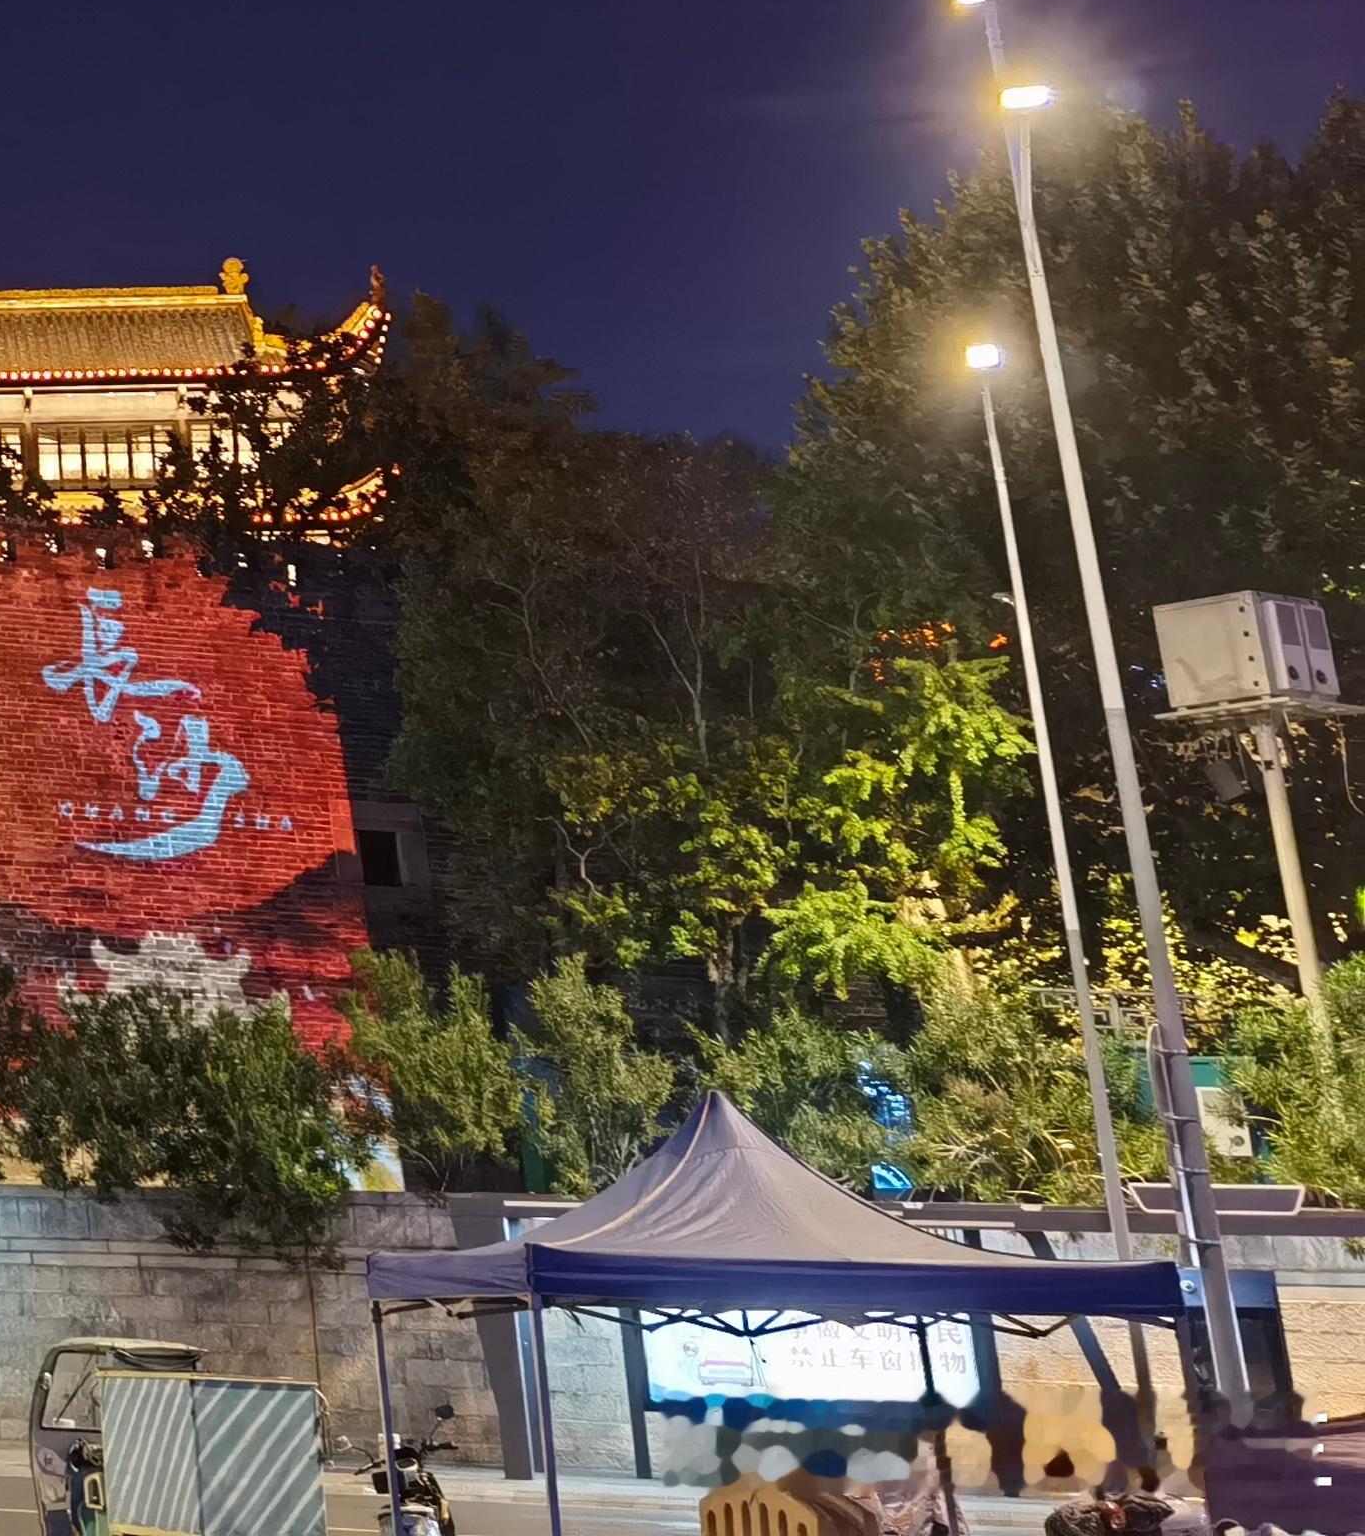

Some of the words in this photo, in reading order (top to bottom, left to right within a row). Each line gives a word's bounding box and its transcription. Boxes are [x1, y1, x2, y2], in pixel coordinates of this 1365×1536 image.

[234, 810, 293, 831] SHA
[788, 1317, 964, 1346] 争做文明民
